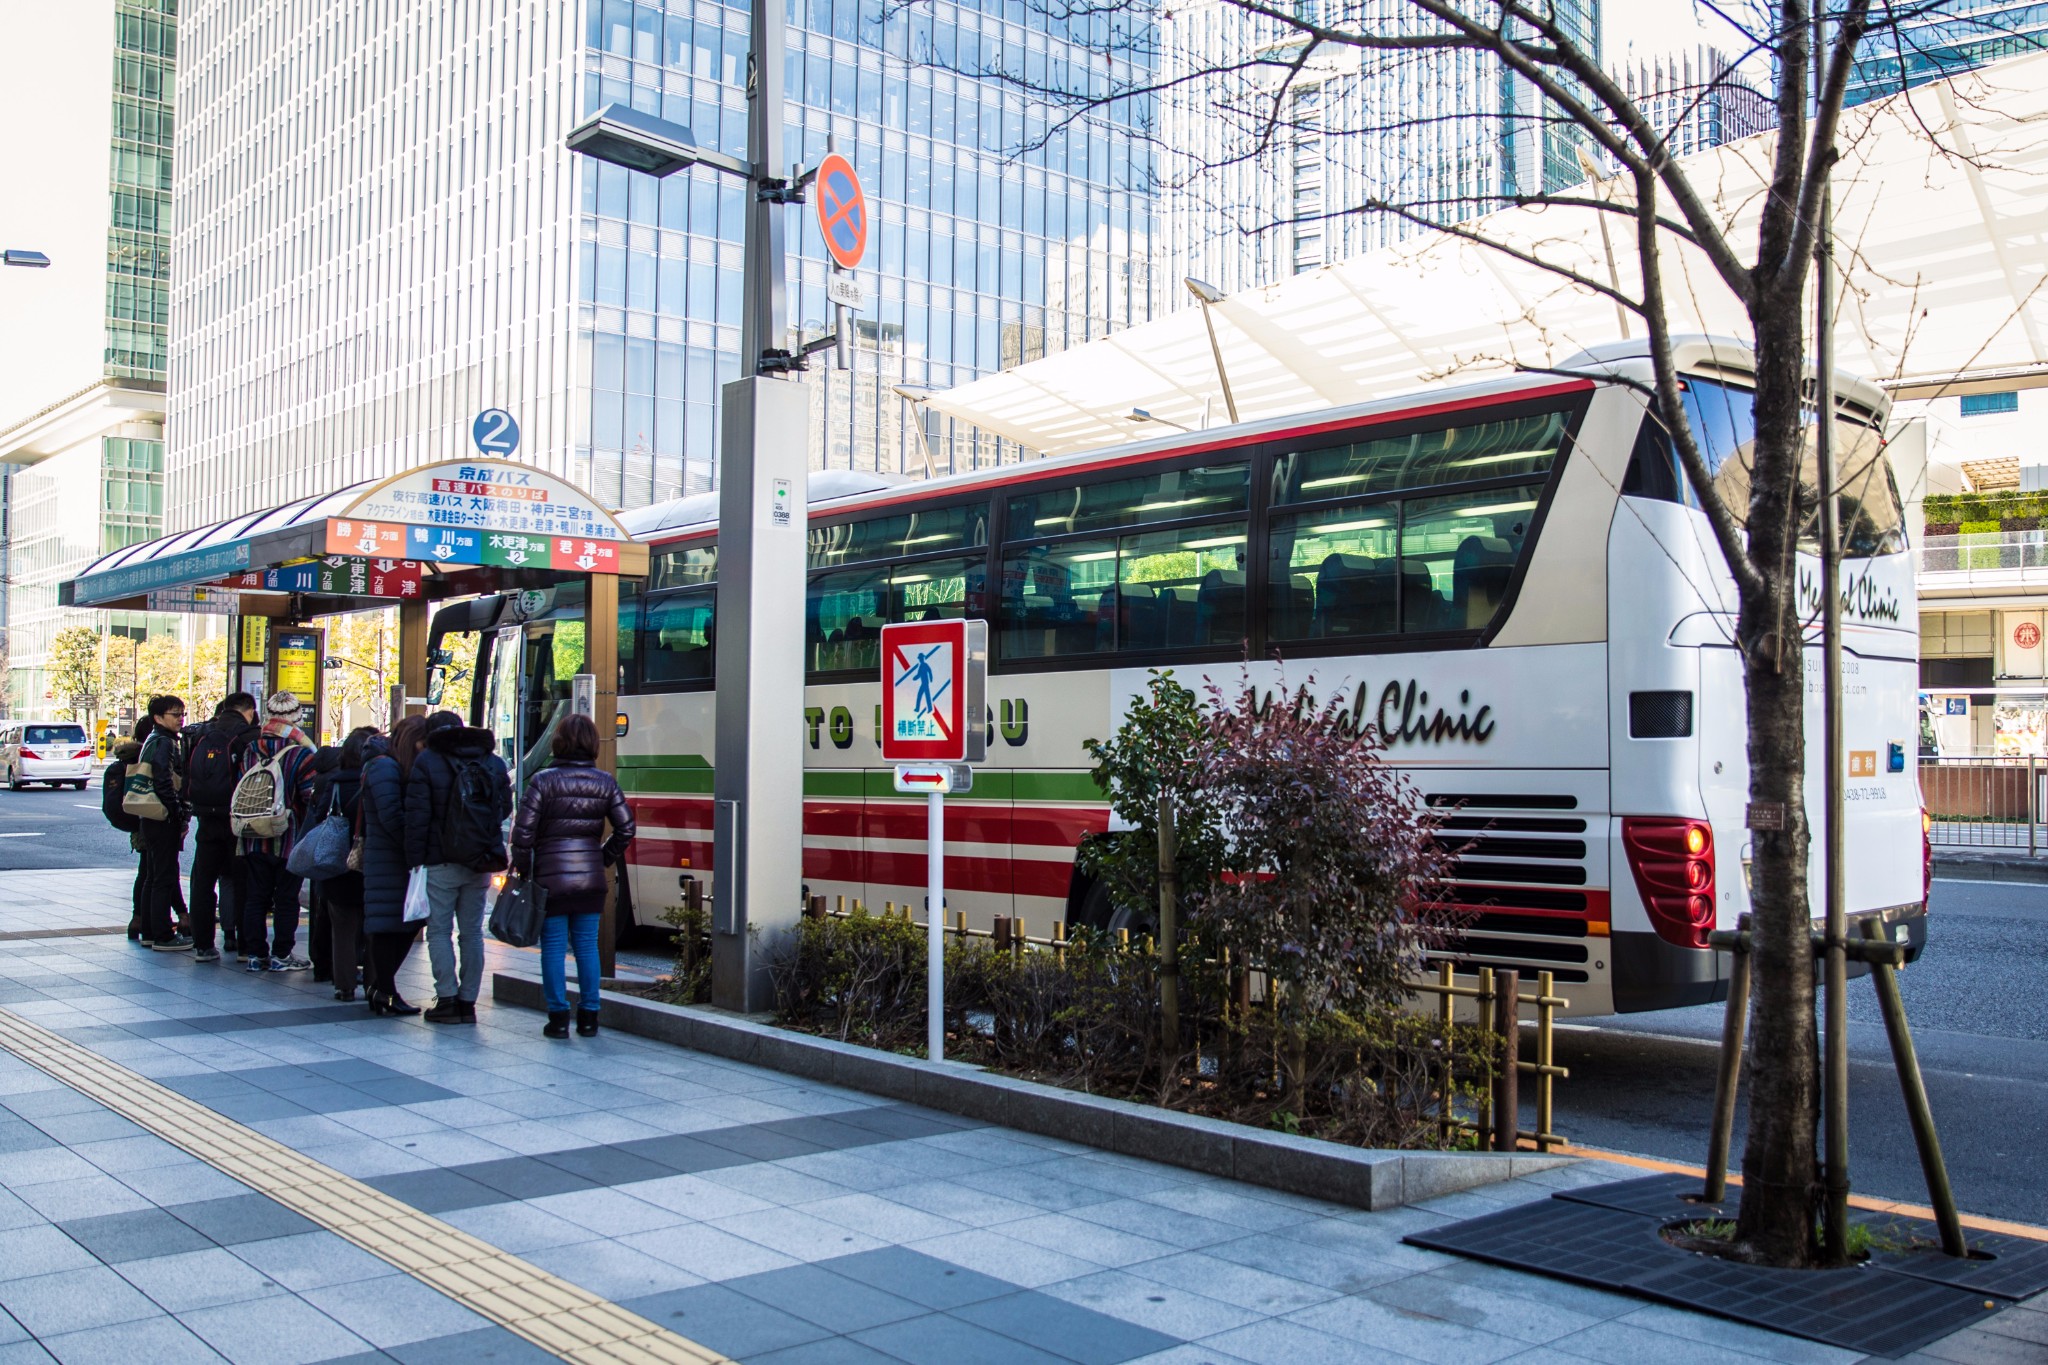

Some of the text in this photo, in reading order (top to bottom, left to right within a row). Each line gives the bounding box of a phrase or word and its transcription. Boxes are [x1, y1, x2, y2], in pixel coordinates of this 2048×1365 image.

[481, 411, 510, 448] 2
[458, 466, 531, 486] 京成バス
[392, 490, 463, 508] 夜行高速バス
[437, 480, 545, 501] 高速バスのりば
[773, 511, 790, 519] 0388
[363, 540, 371, 553] 4
[440, 546, 448, 558] 3
[514, 551, 522, 563] 2
[583, 557, 589, 568] 1
[322, 571, 334, 591] 方面
[373, 575, 385, 595] 方面
[1800, 564, 1899, 622] Meal Clinic
[1841, 661, 1859, 676] 2008
[1379, 678, 1495, 744] Clinic
[1948, 701, 1956, 713] 9
[897, 719, 937, 737] 横断禁止
[1851, 755, 1874, 773] 歯科
